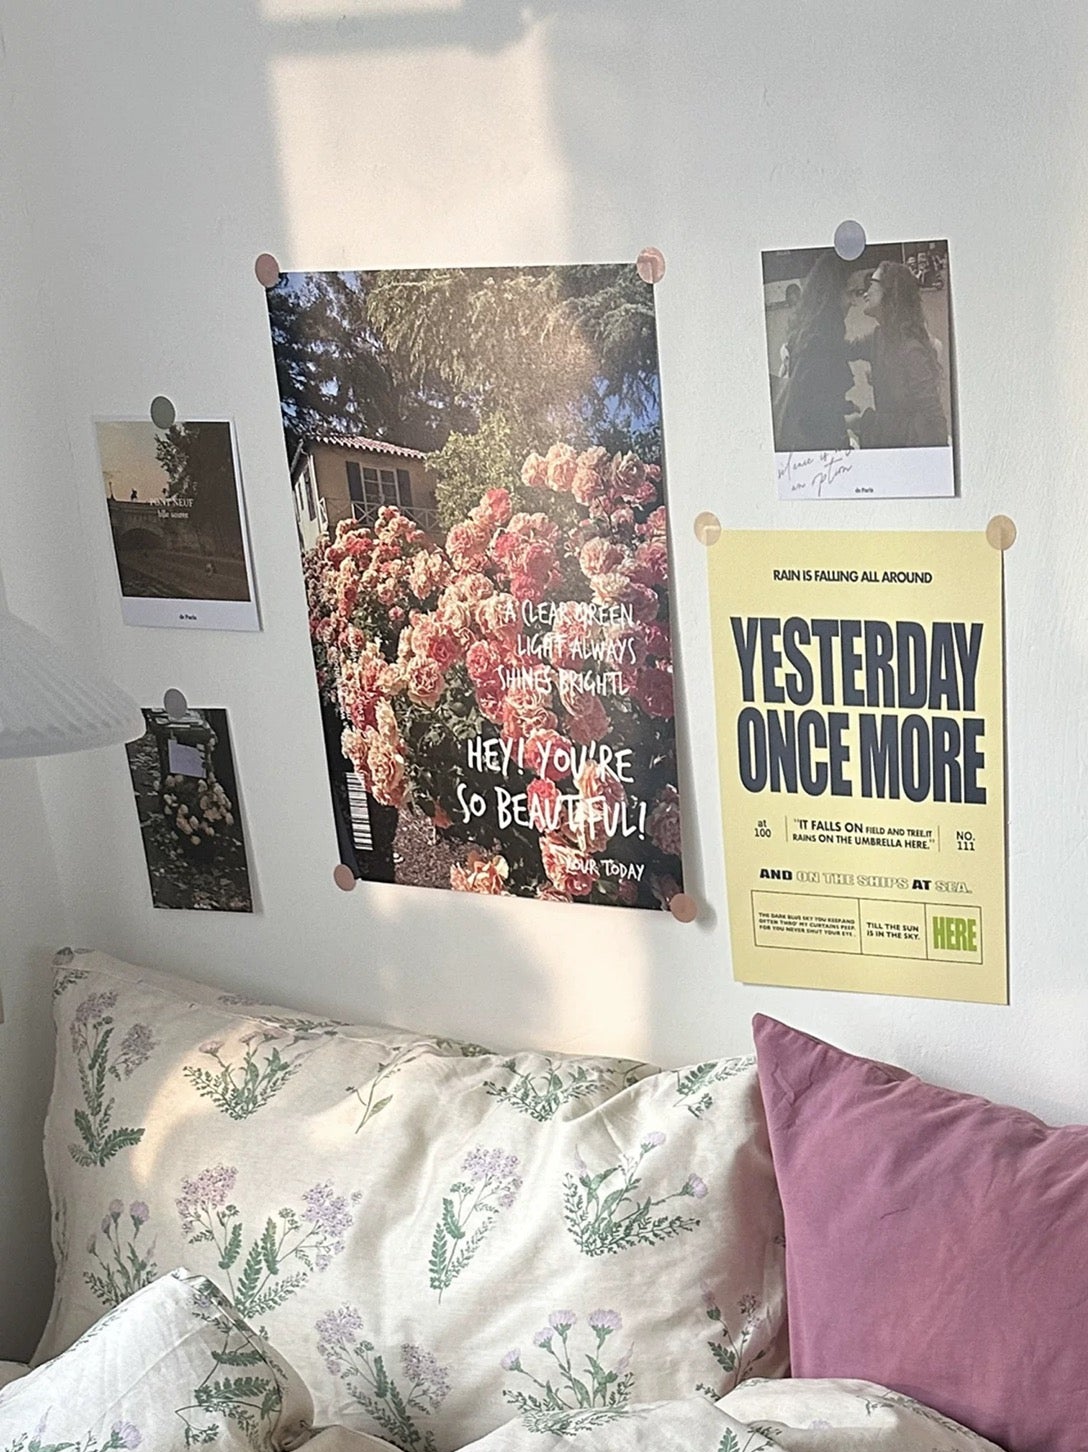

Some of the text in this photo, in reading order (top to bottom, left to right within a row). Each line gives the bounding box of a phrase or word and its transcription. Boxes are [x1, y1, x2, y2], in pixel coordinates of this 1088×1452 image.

[773, 569, 933, 584] RAIN IS FALLING ALL AROUND
[504, 602, 516, 623] A
[522, 599, 571, 627] CLEAR
[517, 631, 636, 664] LIGHT ALWAYS
[730, 616, 984, 712] YESTERDAY
[497, 664, 552, 694] SHINES
[468, 736, 634, 790] HEY! YOU'RE
[737, 706, 987, 805] ONCE MORE
[457, 783, 647, 846] SO BEAUTIFUL!
[757, 819, 767, 828] at
[754, 828, 772, 838] 100
[811, 820, 842, 832] FALLS
[844, 822, 864, 834] ON
[866, 826, 886, 836] FIELD
[887, 828, 905, 836] AND
[956, 830, 976, 841] NO.
[792, 833, 816, 842] RAINS
[818, 834, 834, 843] ON
[836, 835, 852, 845] THE
[854, 836, 902, 848] UMBRELLA
[957, 841, 976, 852] 111
[601, 859, 645, 881] TODAY
[760, 868, 793, 880] AND
[796, 870, 820, 884] ON
[822, 872, 855, 886] THE
[856, 874, 909, 890] SHIPS
[912, 879, 932, 890] AT
[866, 922, 920, 932] TILL THE SUN
[875, 930, 884, 938] IN
[932, 916, 978, 952] HERE
